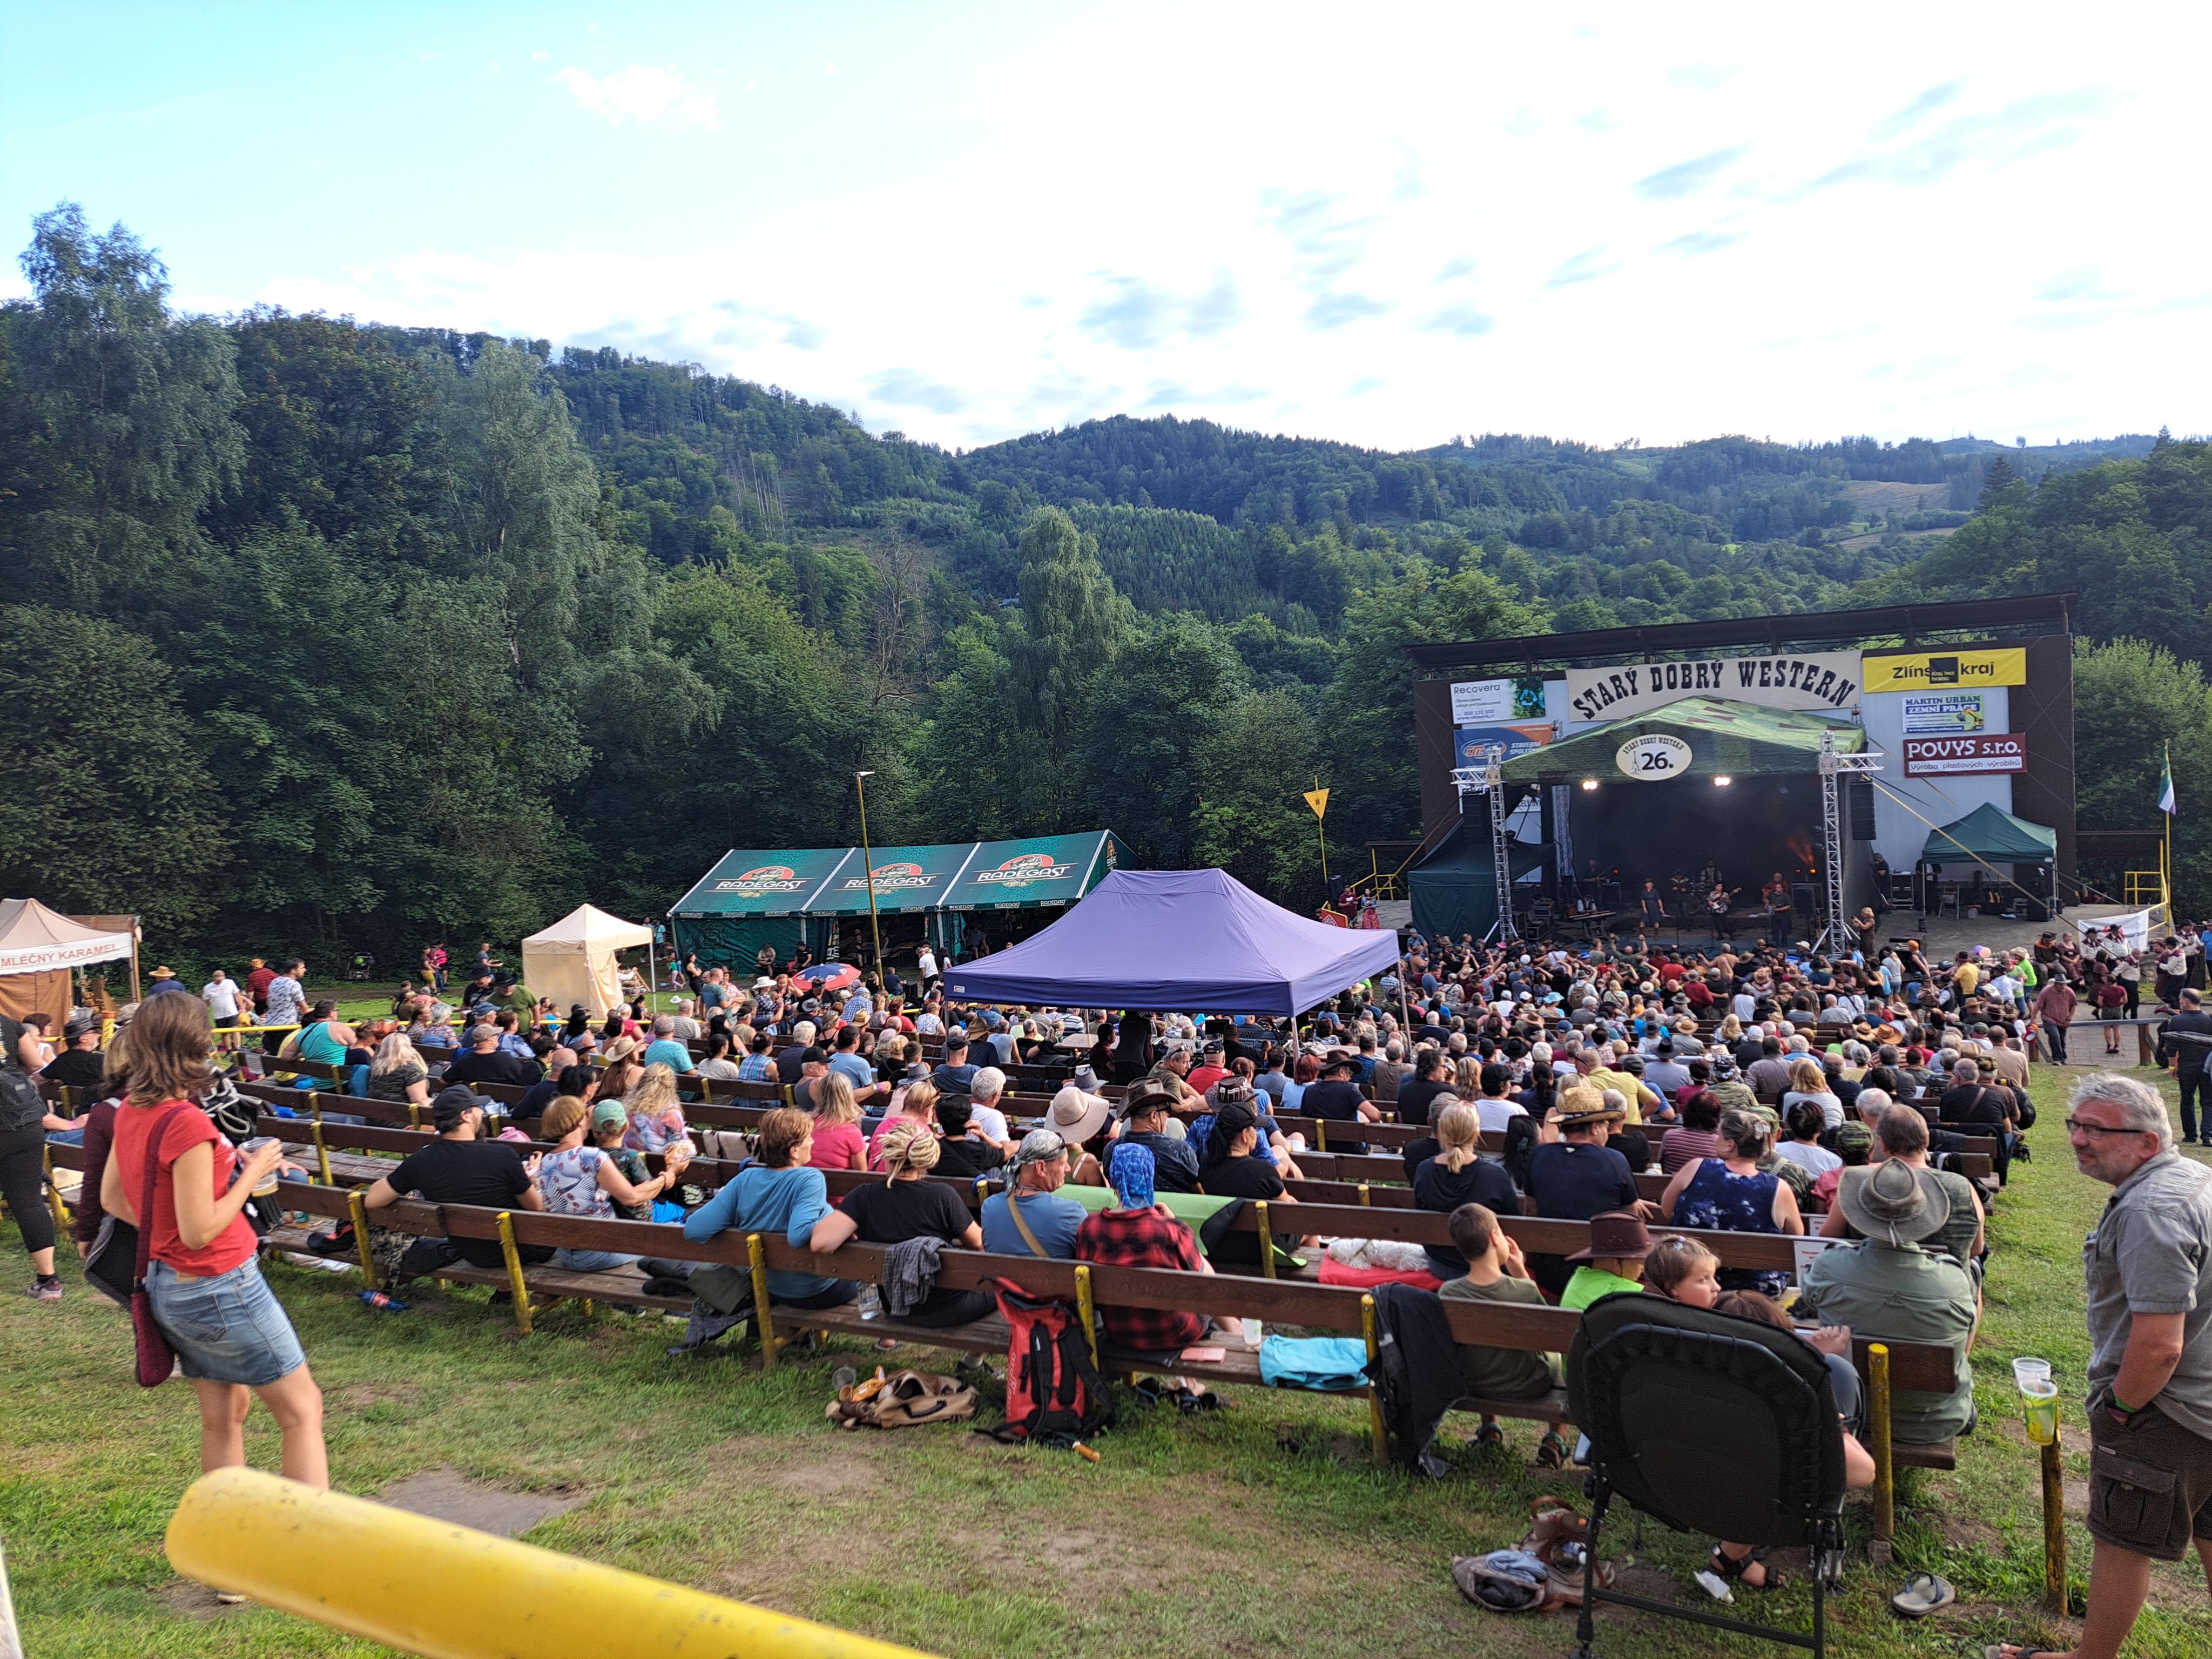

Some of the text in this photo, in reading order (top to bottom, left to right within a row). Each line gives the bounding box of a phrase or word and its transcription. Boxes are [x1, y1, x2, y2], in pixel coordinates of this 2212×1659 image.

[1960, 662, 1994, 676] kraj
[1454, 684, 1501, 694] Recovera
[1573, 659, 1856, 720] STARÝ DOBRÝ WESTERN
[1906, 697, 1943, 705] MARTIN
[1908, 705, 1940, 714] ZEMNÍ
[1907, 740, 2022, 758] POVYS s.r.o.
[1641, 751, 1674, 771] 26.
[1911, 759, 2020, 771] Výroba plastových výrobků
[977, 866, 1070, 881] RADEGAST
[714, 880, 807, 890] RADEGAST
[844, 876, 936, 888] RADEGAST
[1, 943, 118, 967] MLÉČNÝ KARAMEL
